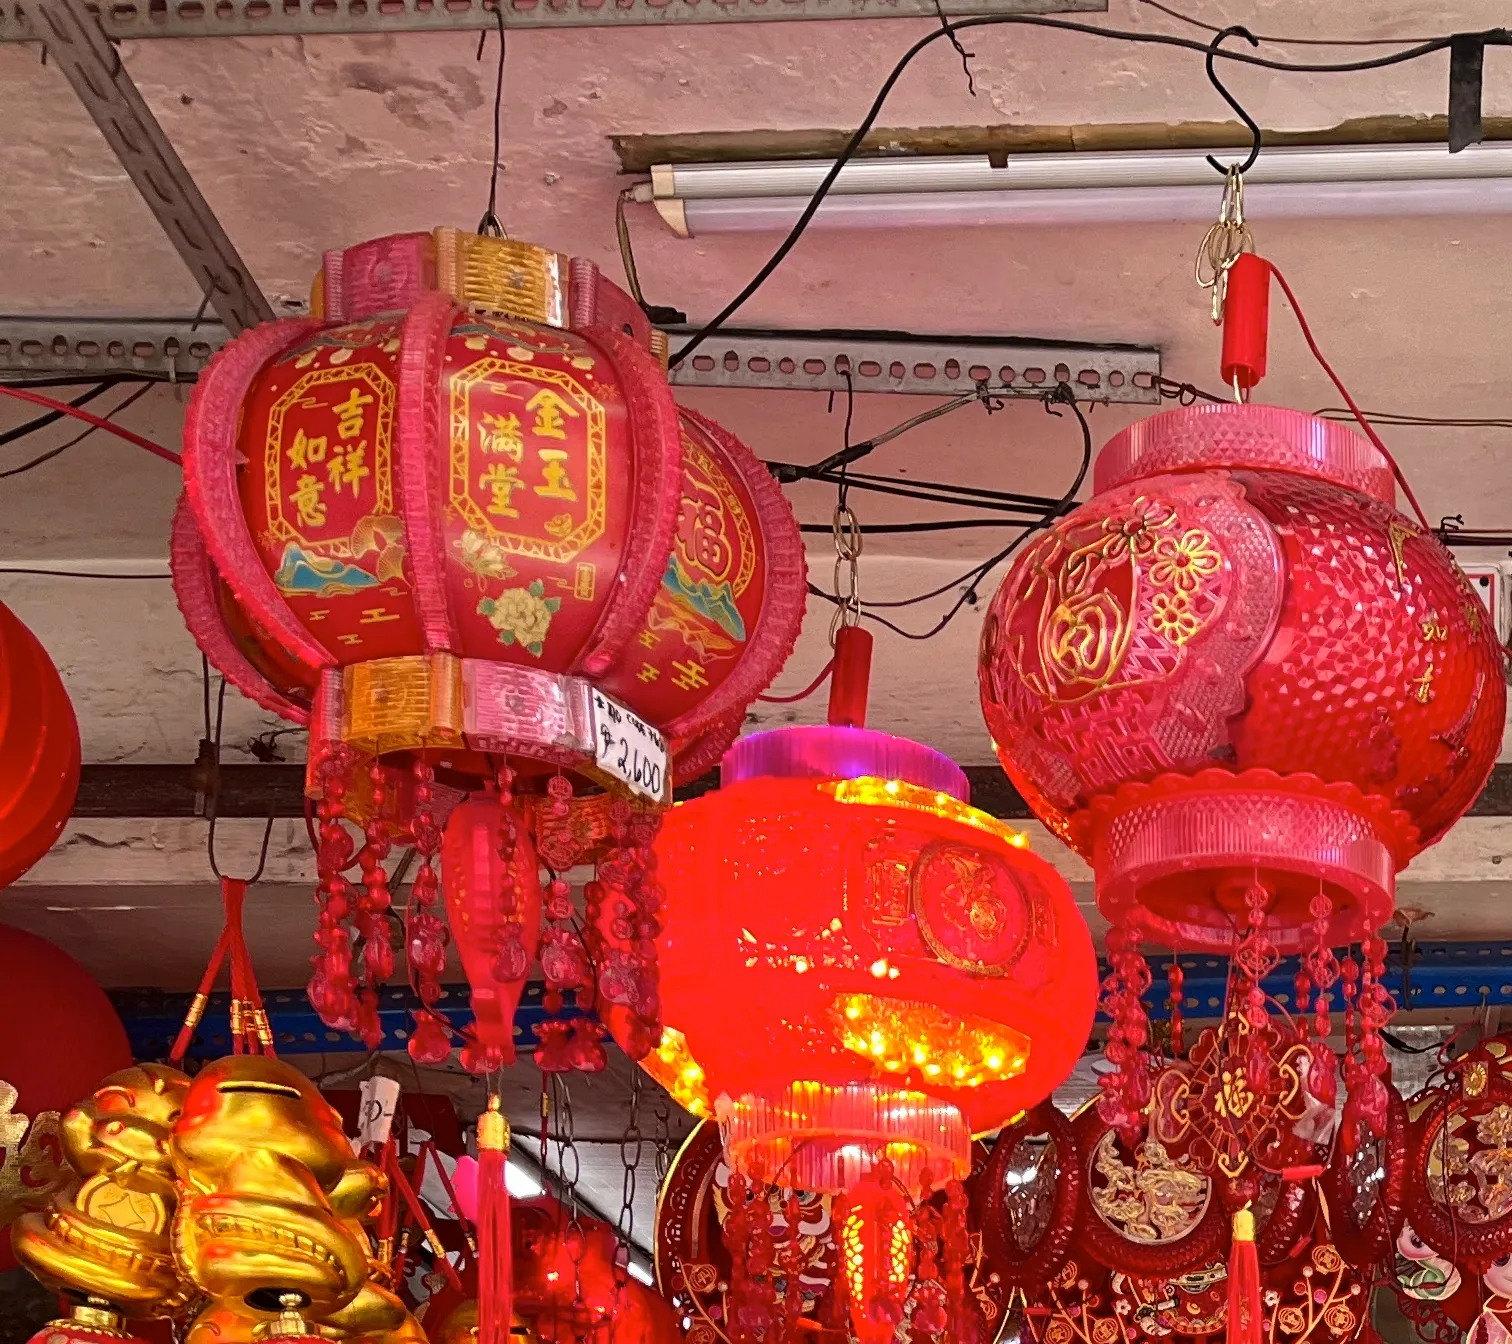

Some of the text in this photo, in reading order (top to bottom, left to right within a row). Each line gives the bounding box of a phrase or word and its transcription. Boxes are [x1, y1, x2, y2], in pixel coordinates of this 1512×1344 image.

[287, 429, 328, 528] 如意
[326, 387, 374, 498] 吉祥
[526, 388, 580, 501] 金玉
[1213, 1066, 1255, 1119] 福
